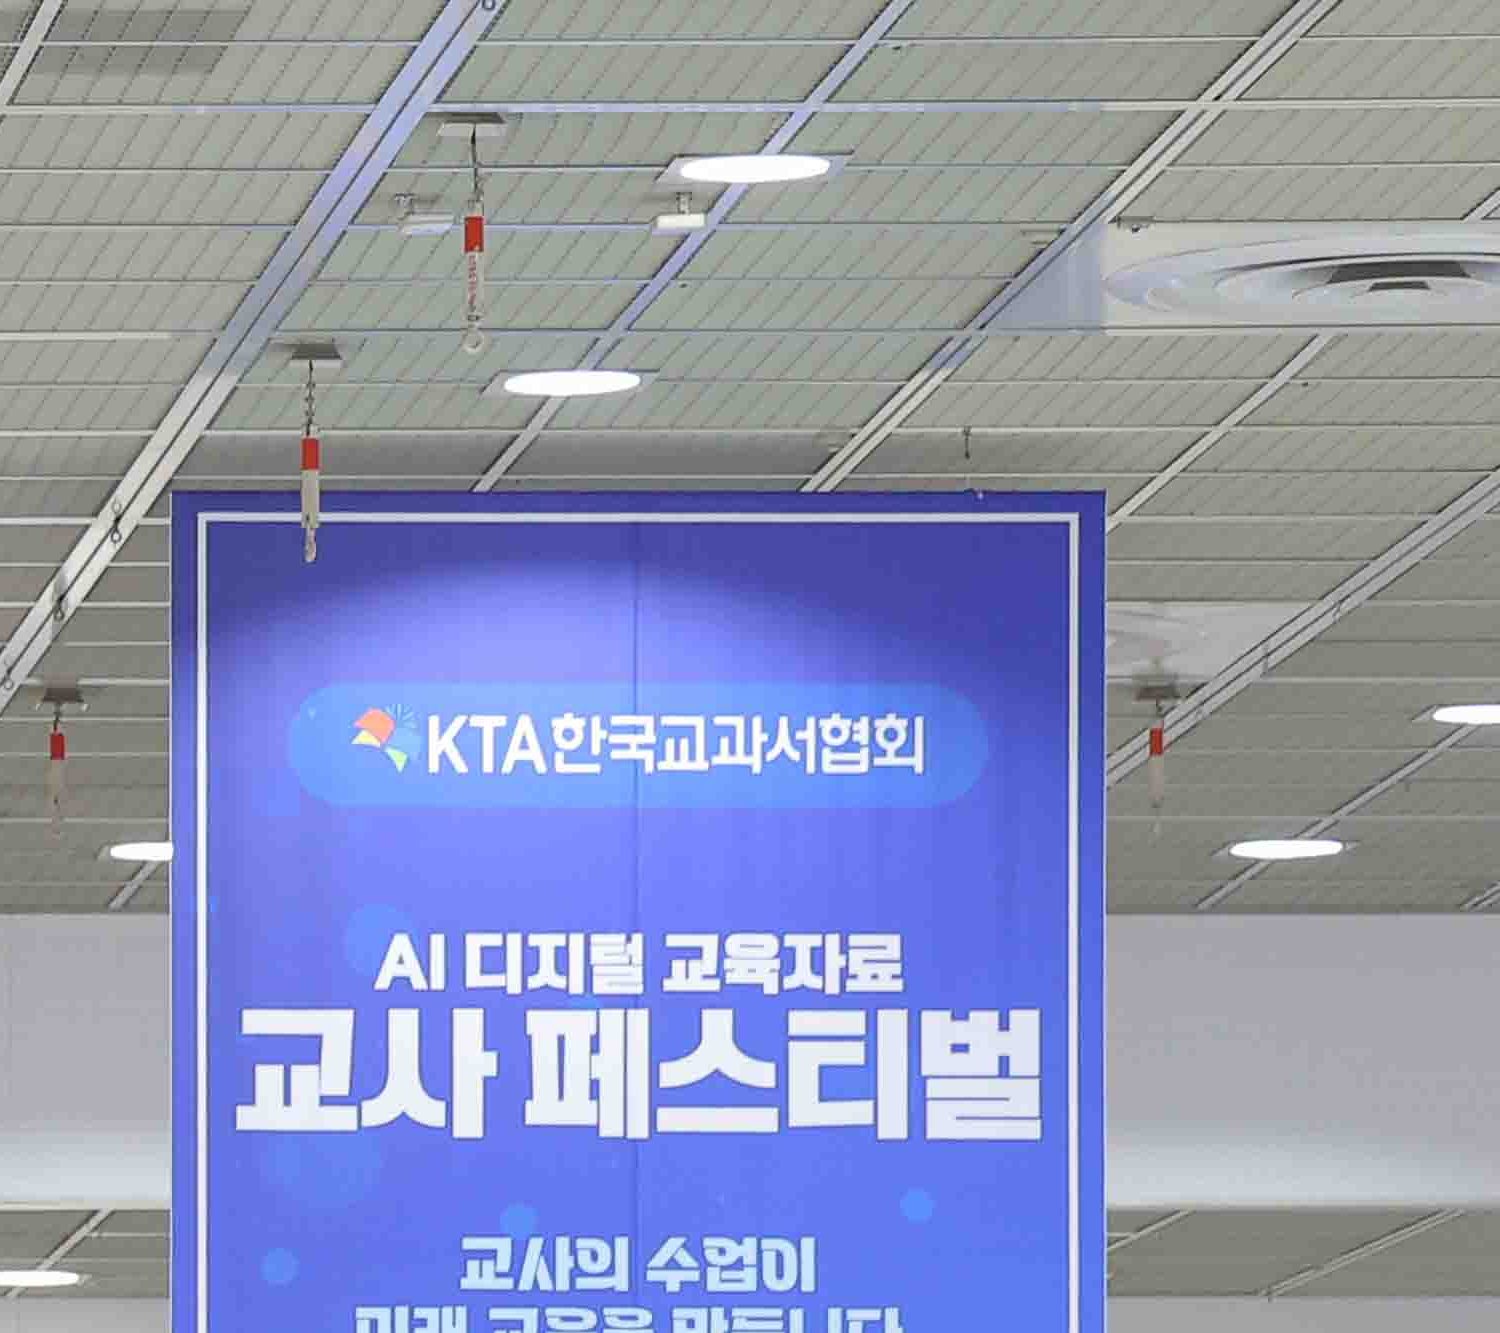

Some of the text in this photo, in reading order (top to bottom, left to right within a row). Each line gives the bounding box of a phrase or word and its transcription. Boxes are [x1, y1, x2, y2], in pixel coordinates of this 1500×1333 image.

[427, 712, 926, 775] KTA한국교과서협회
[375, 933, 903, 994] AI 디지털 교육자료
[236, 1008, 1040, 1139] 교사 페스티벌
[460, 1237, 814, 1292] 교사의 수업이
